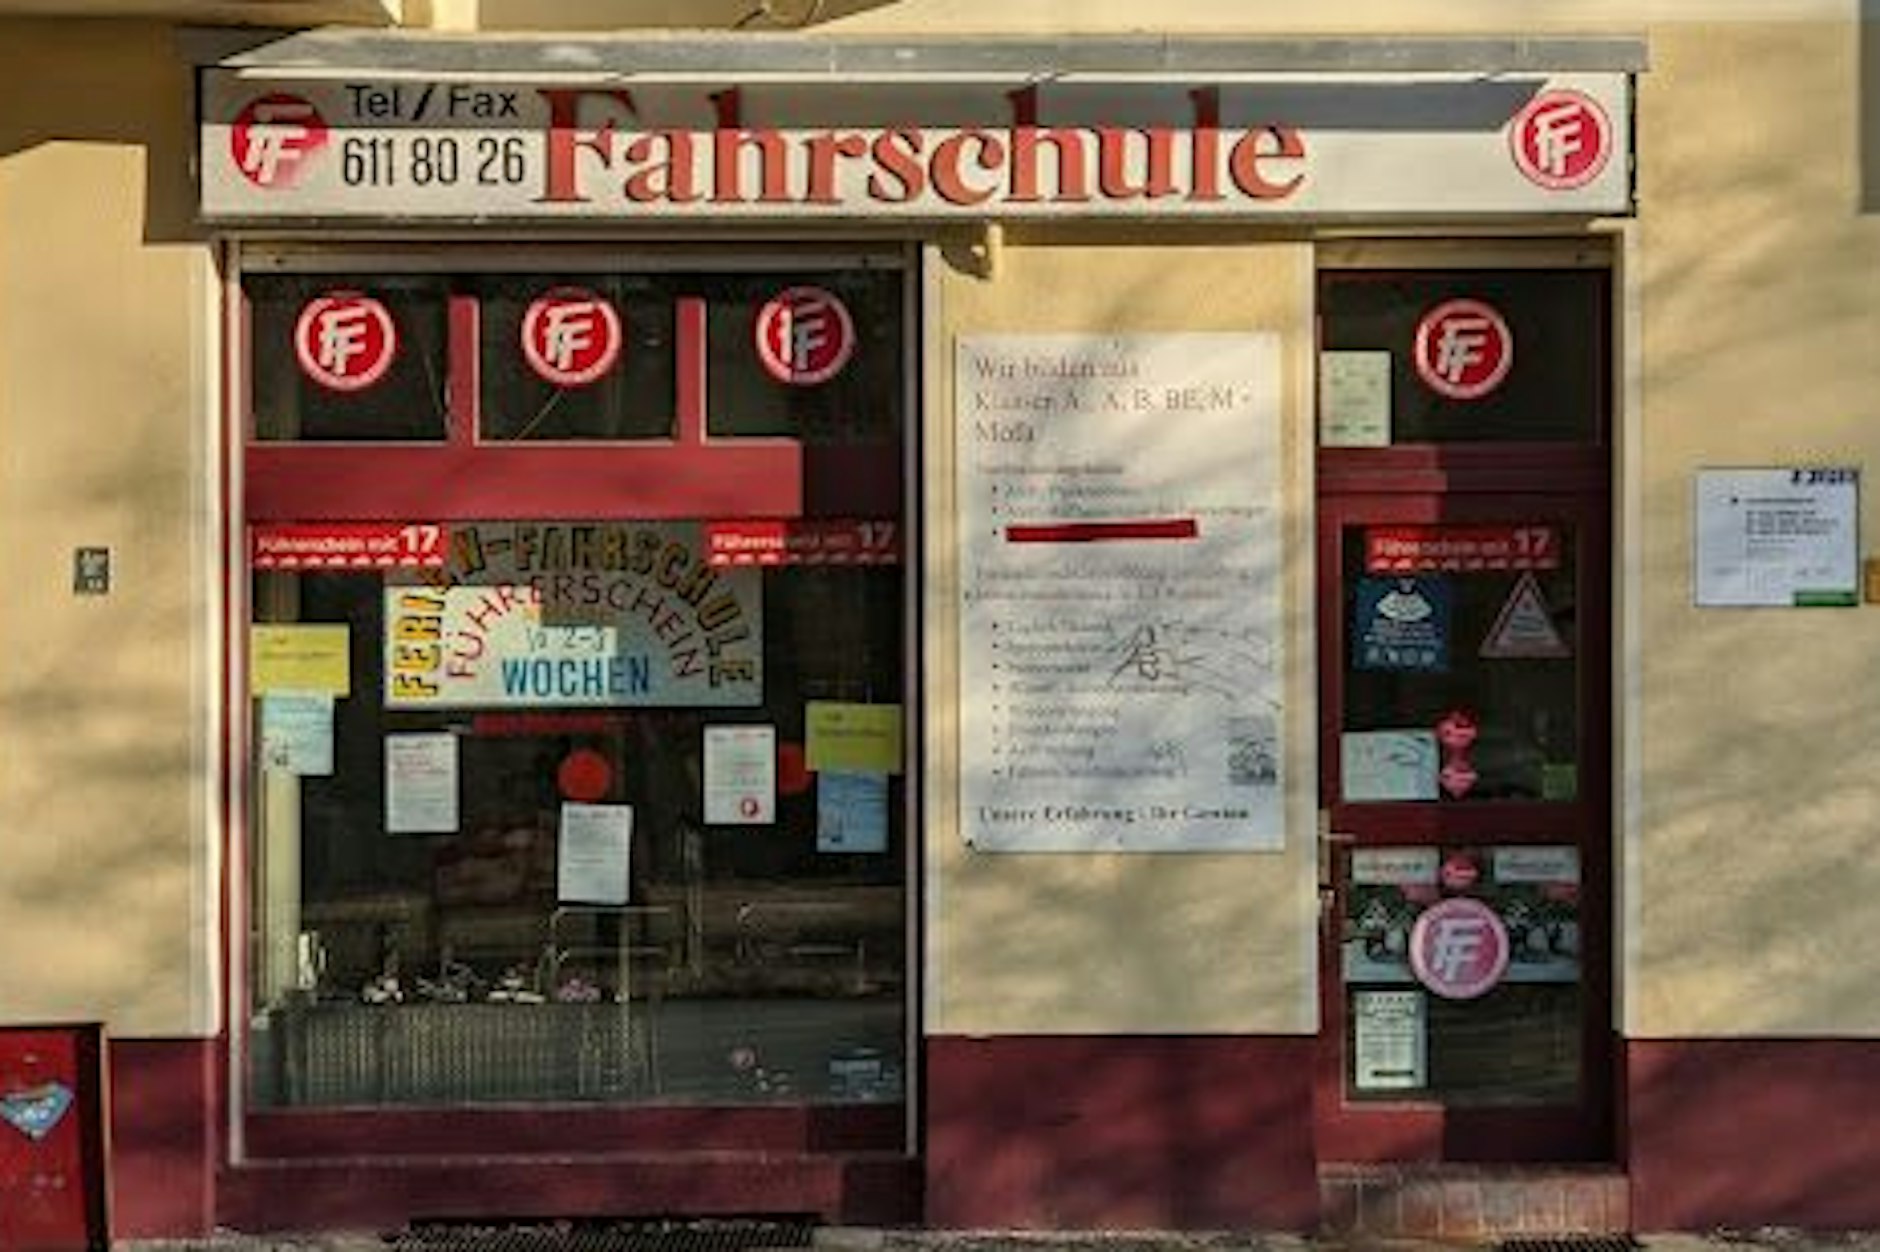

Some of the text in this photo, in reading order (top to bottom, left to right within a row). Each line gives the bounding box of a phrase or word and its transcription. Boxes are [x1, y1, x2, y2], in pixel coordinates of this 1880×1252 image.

[345, 82, 519, 121] Tel / Fax
[533, 84, 1306, 205] Fahrschule
[343, 137, 525, 187] 611 80 26
[975, 356, 1015, 379] Wir
[975, 419, 1035, 444] Mofa
[400, 525, 440, 552] 17
[858, 520, 897, 549] 17
[1513, 526, 1550, 556] 17
[446, 575, 704, 682] FÜHRERSCHEIN
[502, 655, 649, 697] WOCHEN
